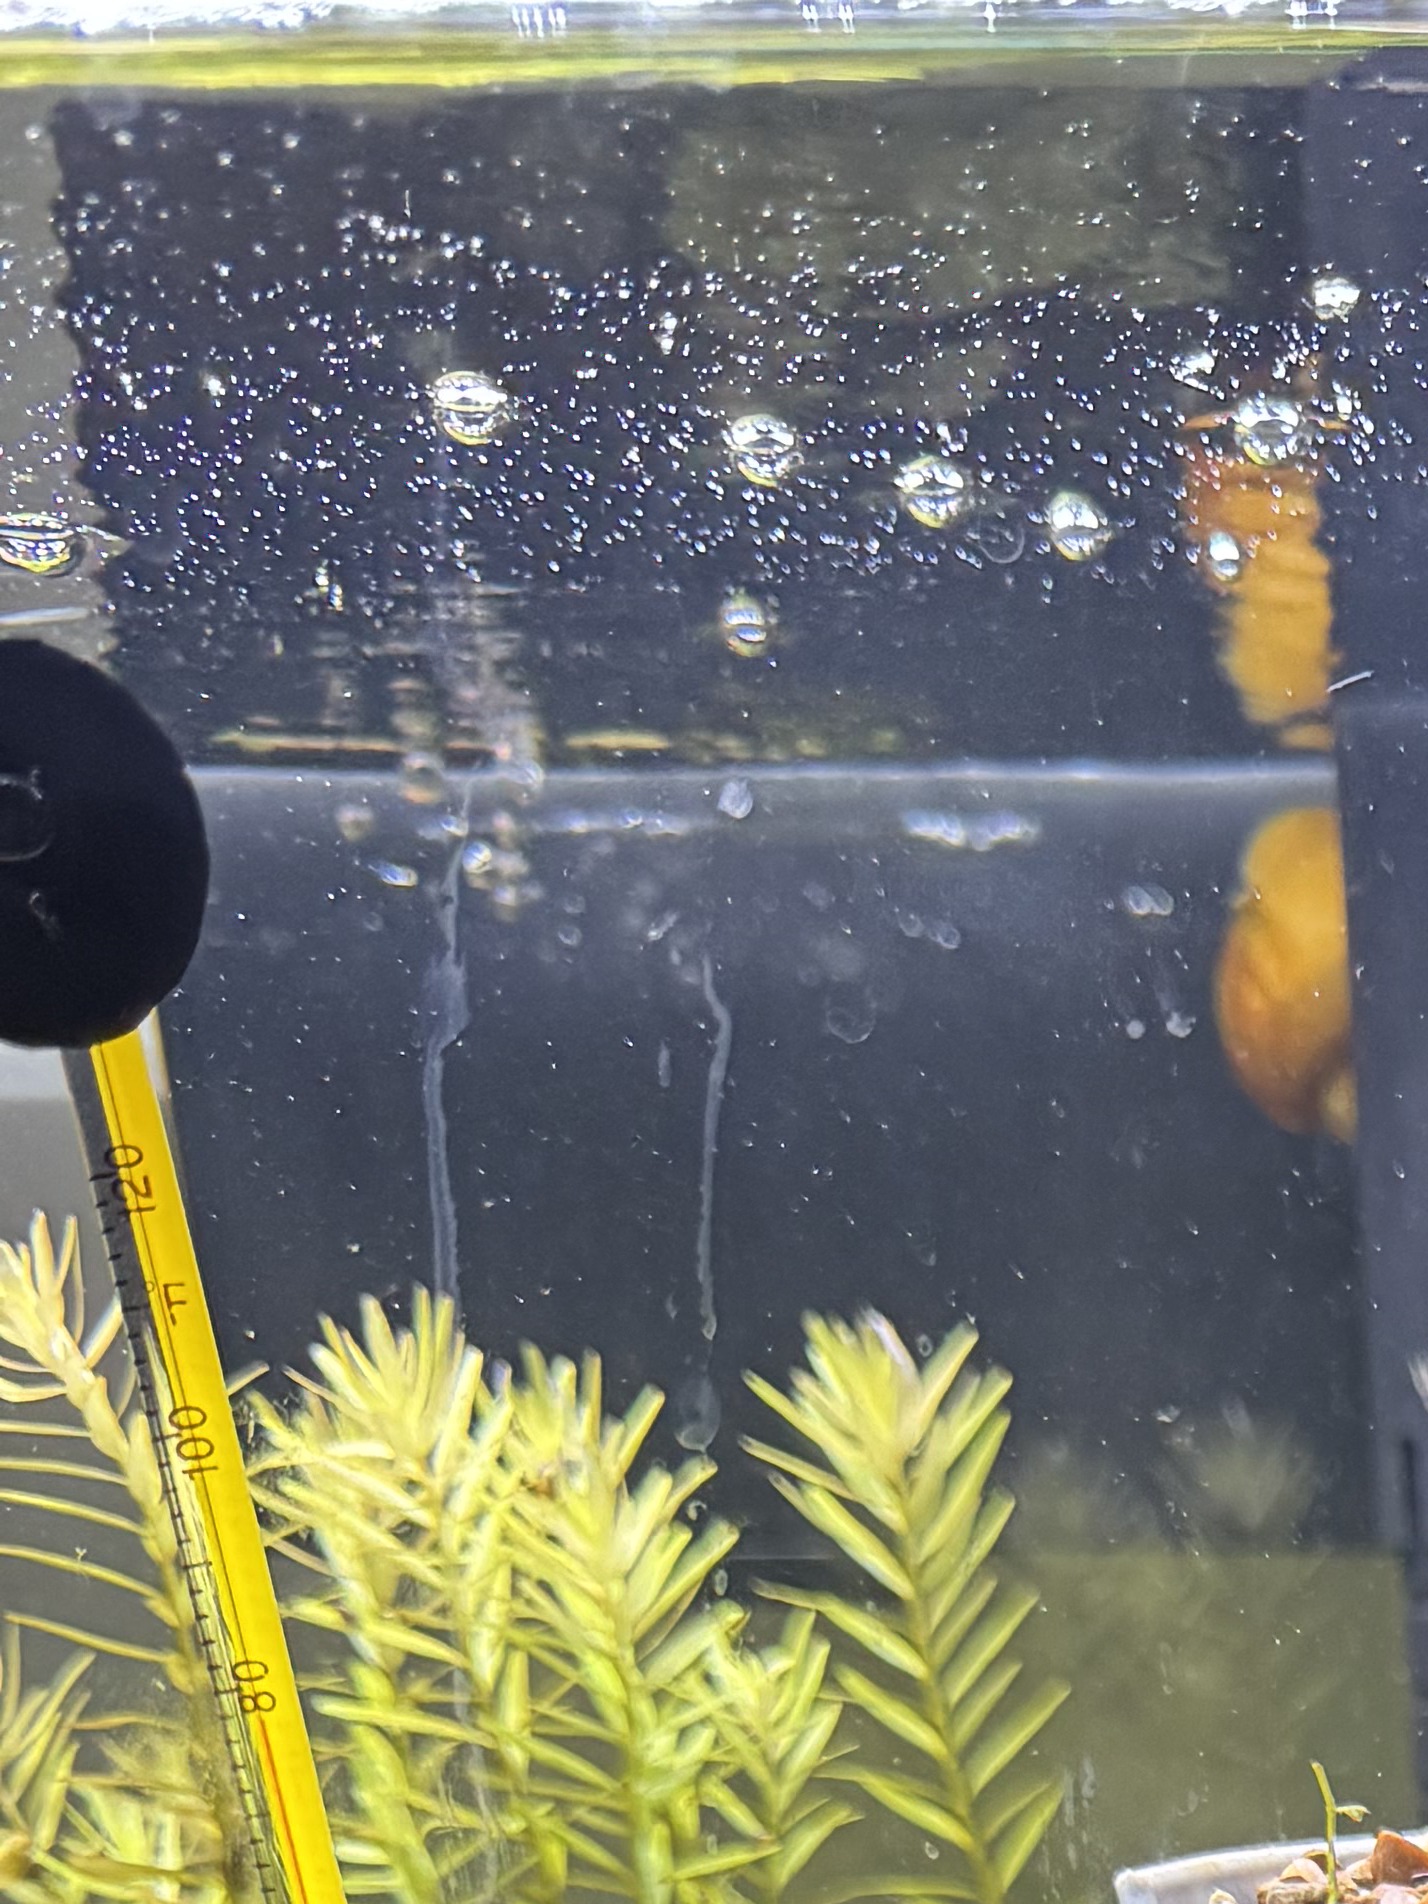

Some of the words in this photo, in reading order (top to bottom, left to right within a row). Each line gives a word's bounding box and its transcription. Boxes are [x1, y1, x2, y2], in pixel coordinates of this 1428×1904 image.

[104, 1144, 156, 1217] 120
[168, 1405, 218, 1480] 100
[232, 1660, 276, 1713] 80
